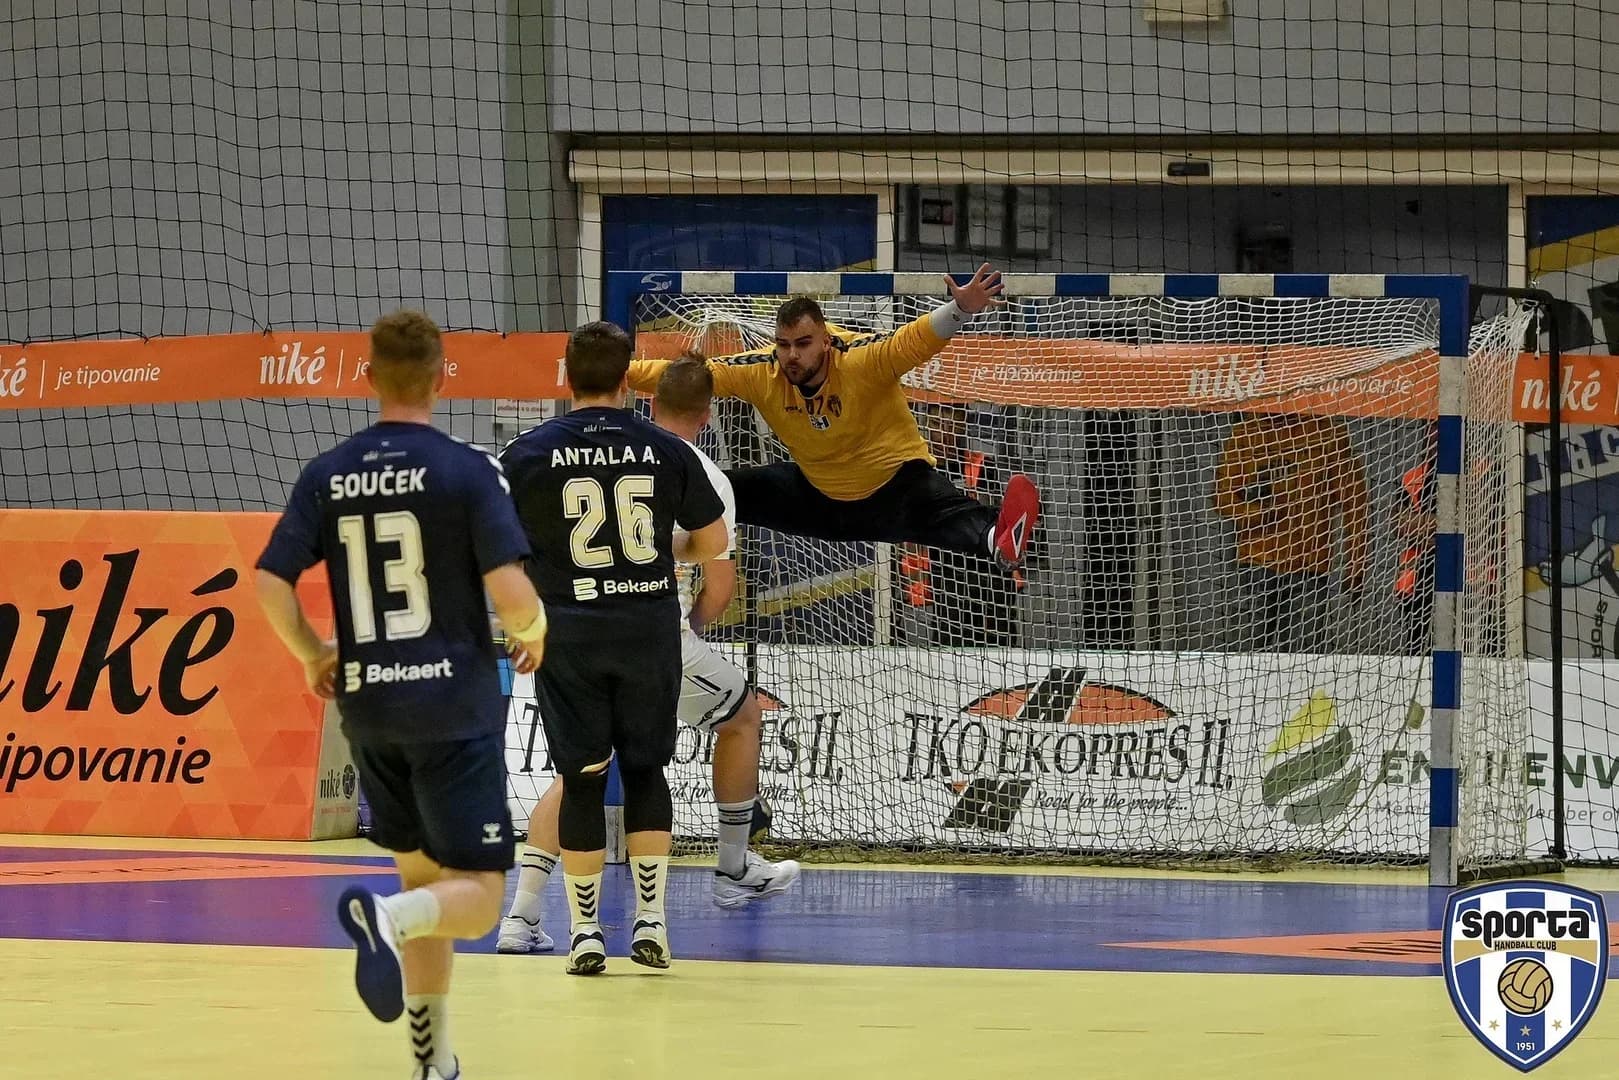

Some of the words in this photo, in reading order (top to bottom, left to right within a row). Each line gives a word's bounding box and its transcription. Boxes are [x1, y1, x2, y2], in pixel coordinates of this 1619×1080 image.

[54, 367, 72, 390] je
[77, 363, 161, 389] tipovanie
[259, 342, 326, 385] niké
[1188, 354, 1265, 400] niké
[1520, 365, 1601, 412] nké
[550, 446, 637, 467] ANTALA
[642, 446, 661, 465] A.
[330, 464, 427, 500] SOUČEK
[562, 475, 659, 568] 26
[337, 510, 432, 644] 13
[603, 576, 669, 594] Bekaert
[365, 658, 453, 683] Bekaert
[320, 768, 341, 799] niké
